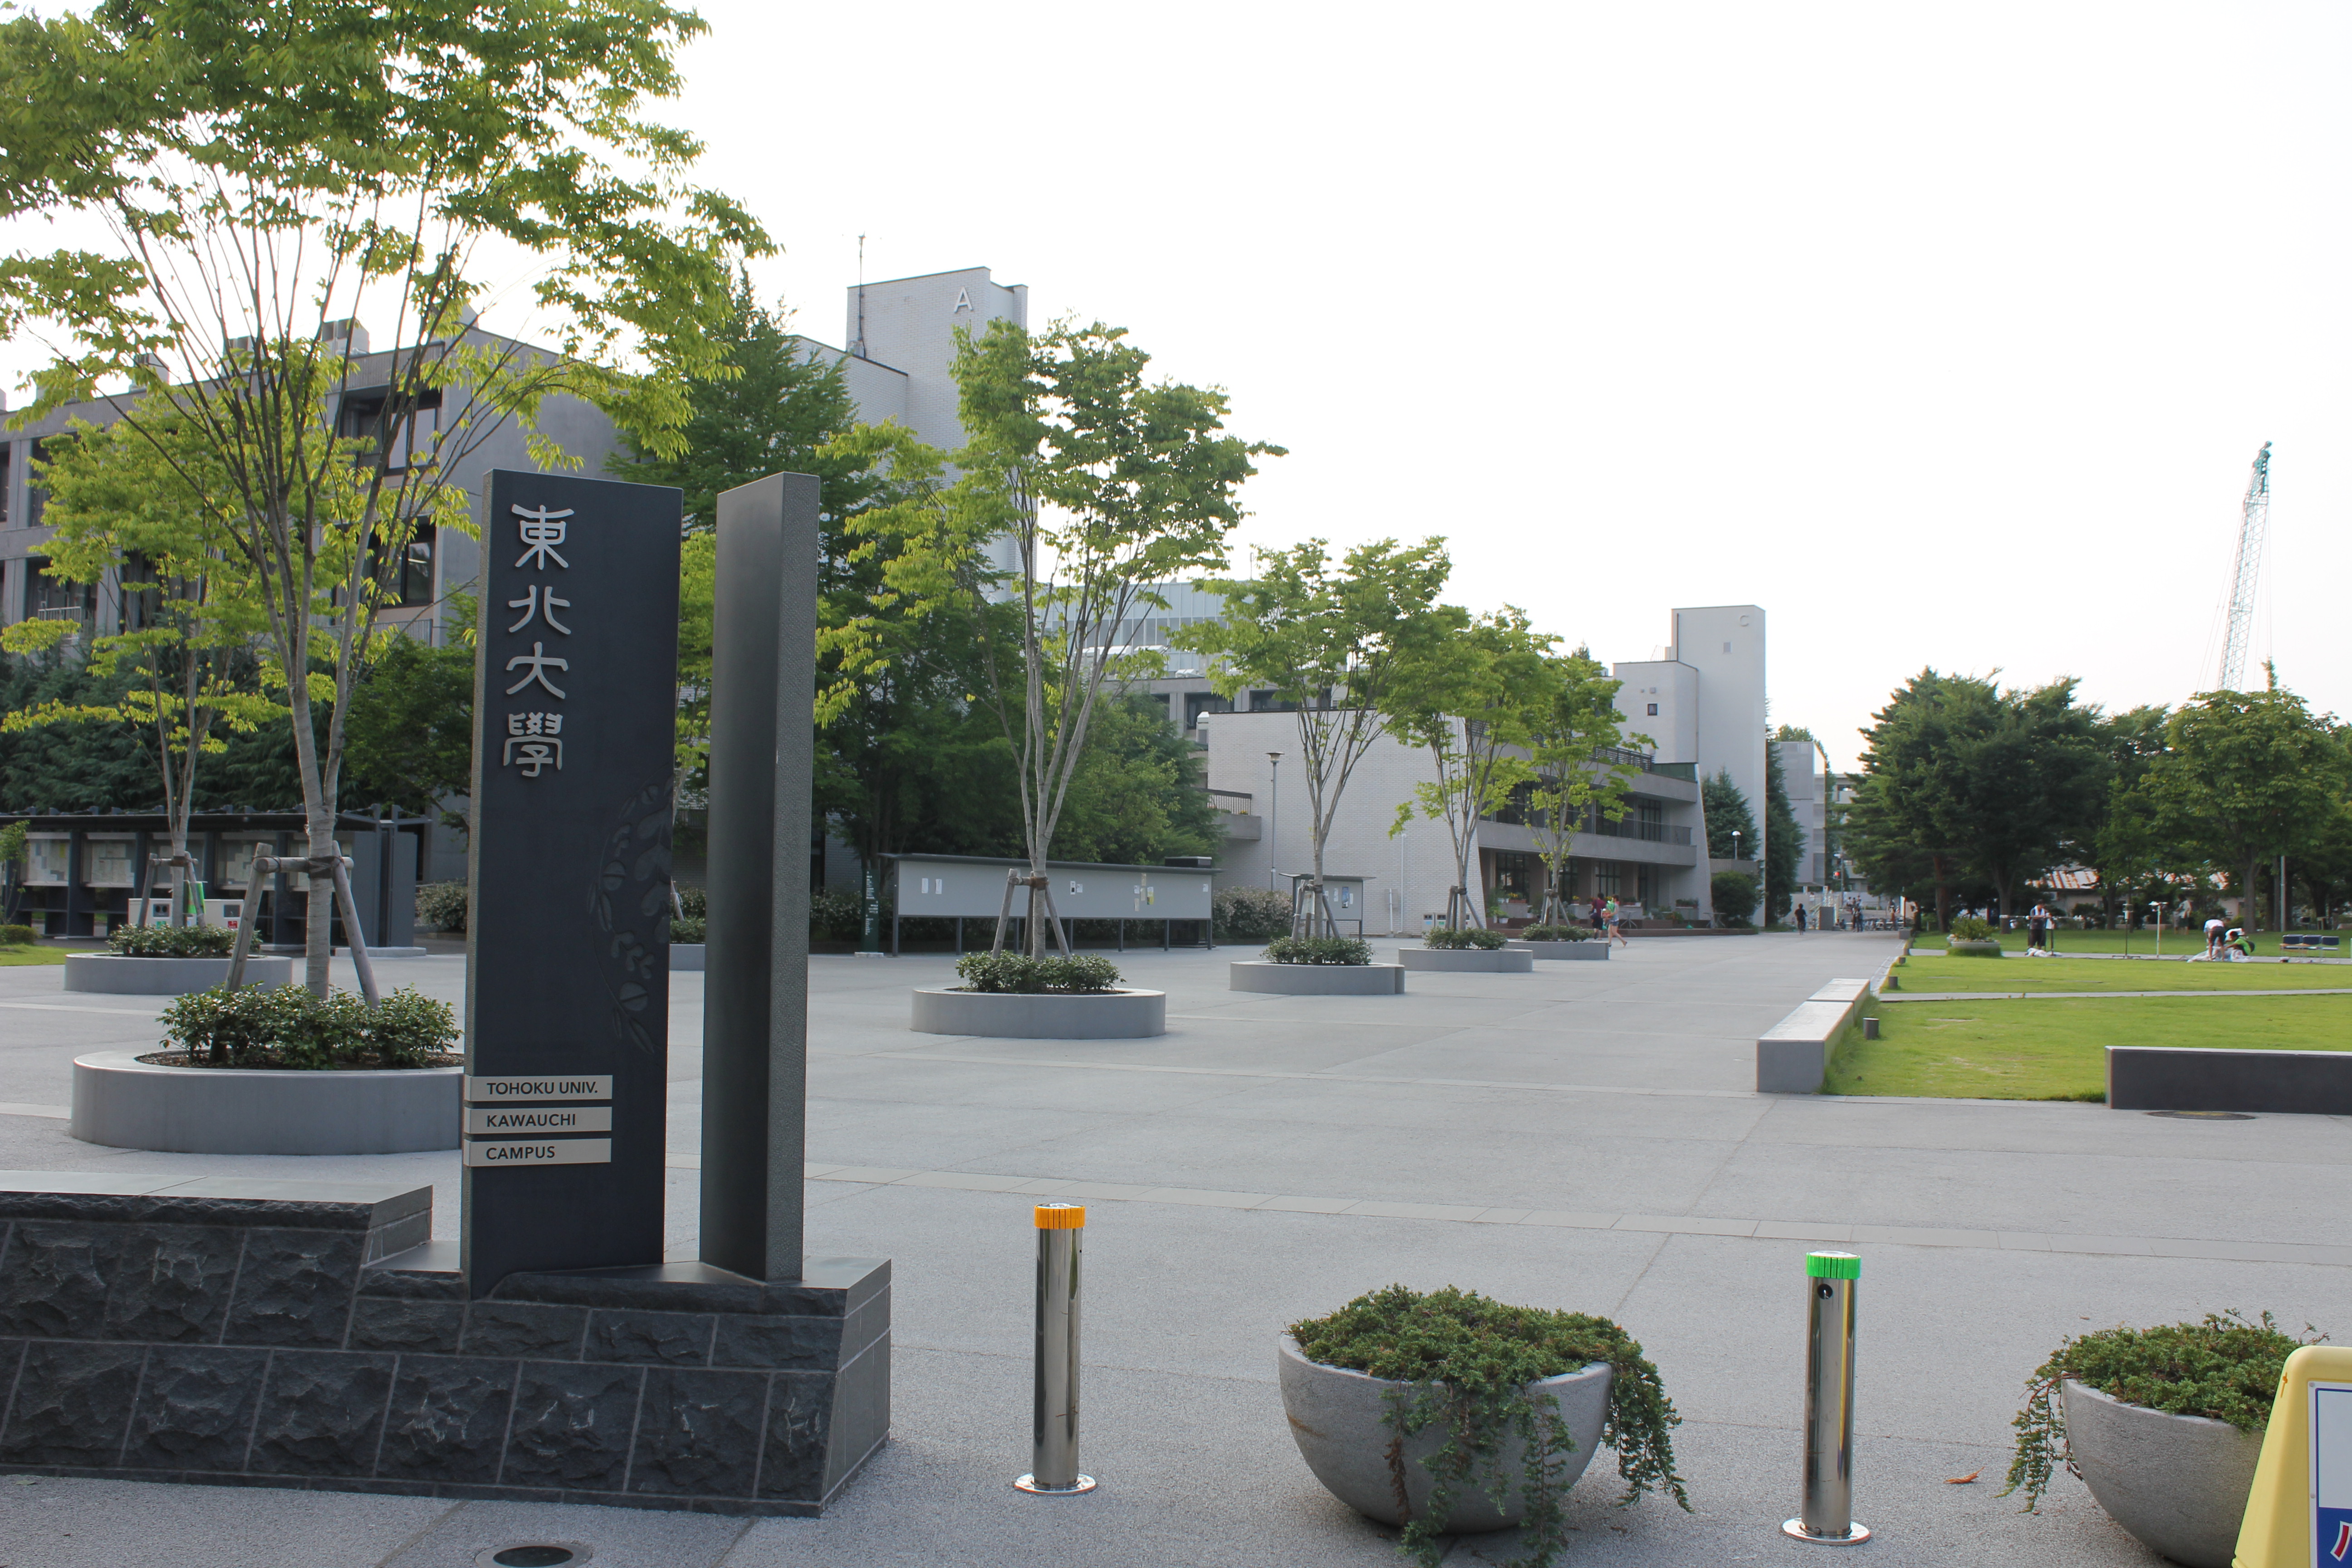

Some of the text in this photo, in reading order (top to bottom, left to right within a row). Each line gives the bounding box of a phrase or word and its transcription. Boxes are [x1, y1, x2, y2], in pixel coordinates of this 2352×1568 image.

[953, 286, 974, 313] A
[1739, 614, 1749, 627] C
[503, 504, 575, 777] 東北大學
[486, 1081, 598, 1095] TOHOKU UNIV.
[487, 1113, 576, 1127] KAWAUCHI
[486, 1146, 555, 1160] CAMPUS
